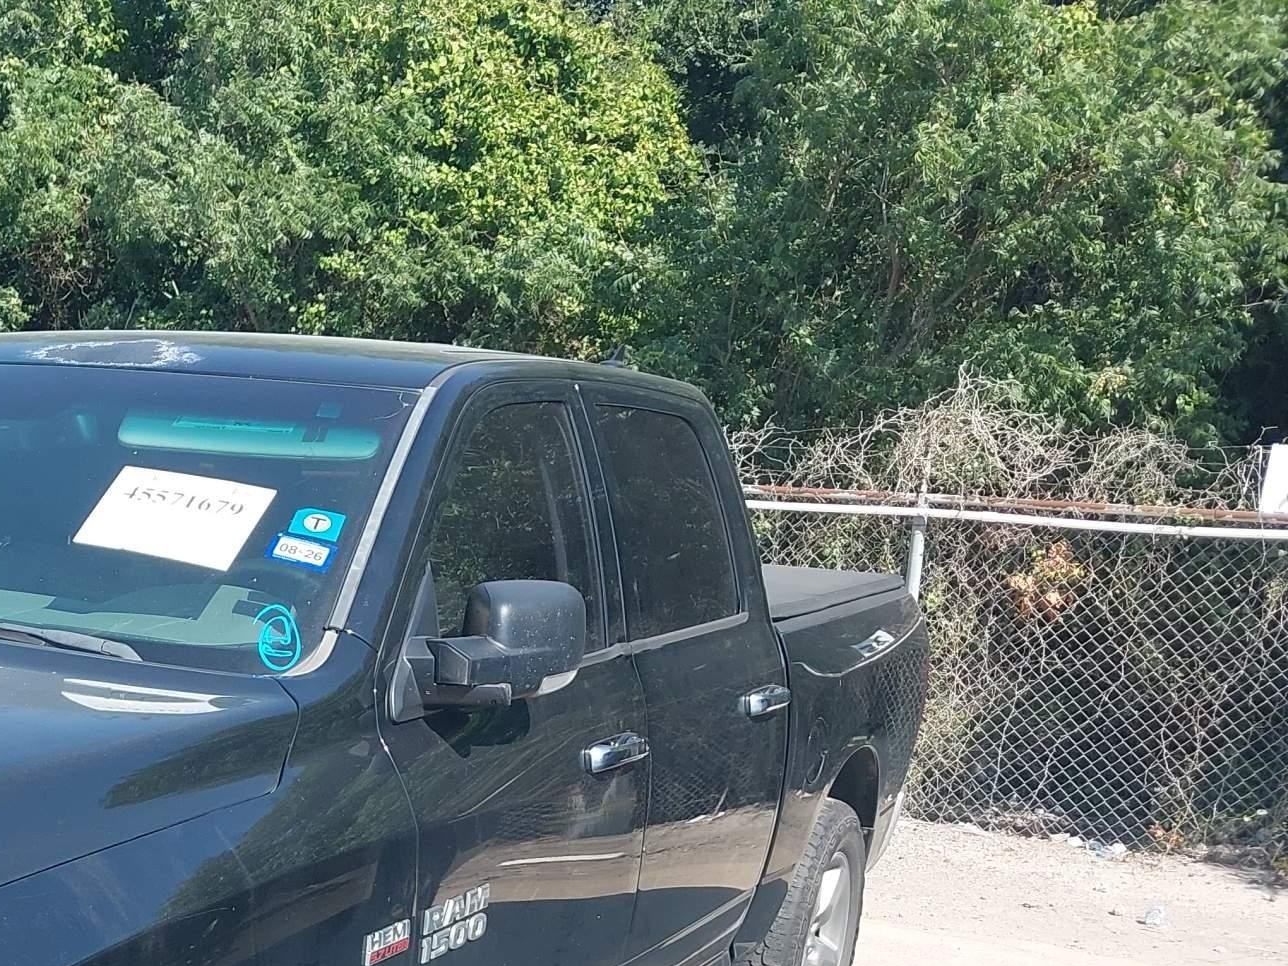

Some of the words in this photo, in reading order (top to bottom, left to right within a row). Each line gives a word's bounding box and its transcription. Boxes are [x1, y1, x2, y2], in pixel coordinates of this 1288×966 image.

[123, 485, 244, 516] 45571679
[310, 515, 328, 531] T
[278, 542, 323, 562] 08-26
[423, 882, 490, 936] RAM
[419, 911, 488, 965] 1500
